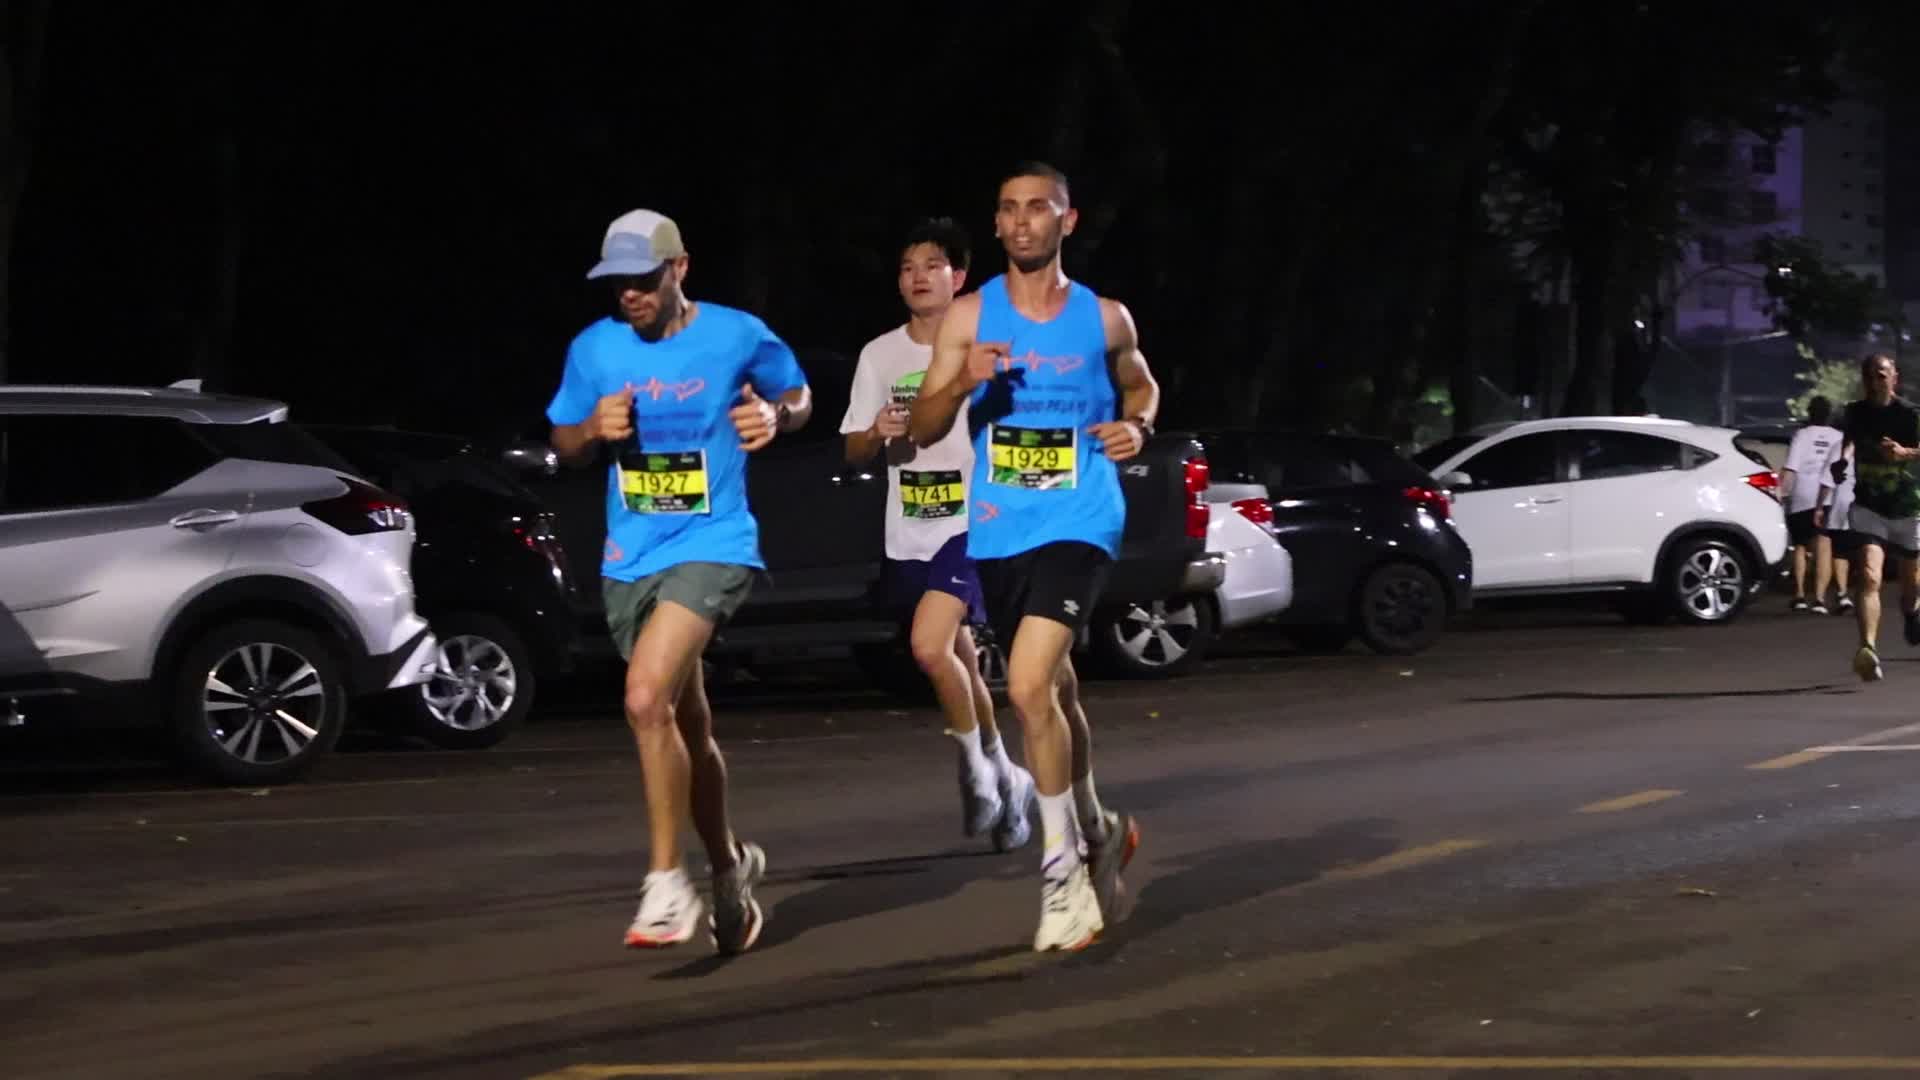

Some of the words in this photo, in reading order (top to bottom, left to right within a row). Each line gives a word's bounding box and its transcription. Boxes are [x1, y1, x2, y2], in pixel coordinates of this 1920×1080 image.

[1006, 447, 1059, 468] 1929
[637, 472, 689, 494] 1927
[910, 485, 951, 503] 1741
